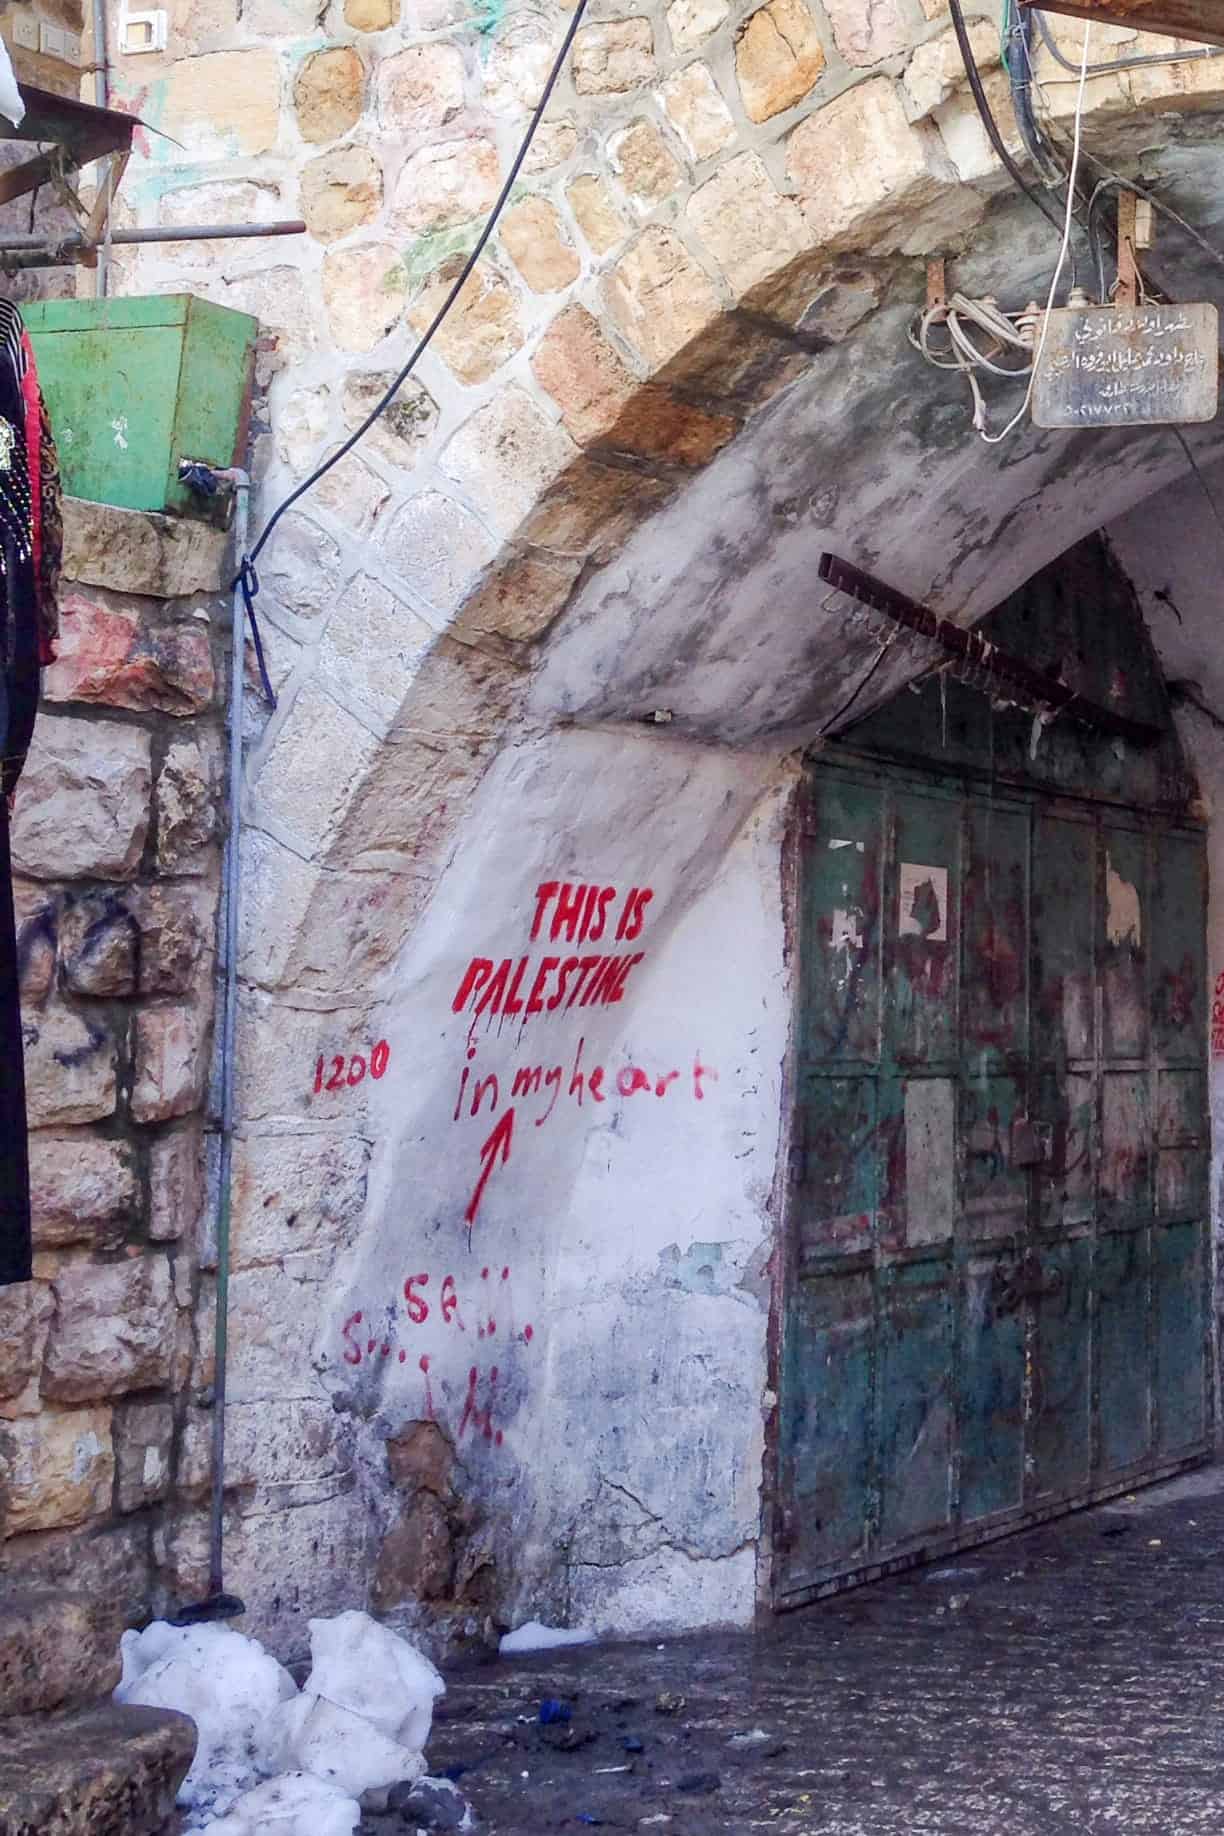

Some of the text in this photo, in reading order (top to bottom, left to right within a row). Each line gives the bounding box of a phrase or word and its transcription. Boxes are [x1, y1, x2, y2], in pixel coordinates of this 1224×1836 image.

[530, 881, 655, 942] THIS IS
[451, 951, 646, 1016] PALESTINE
[453, 1046, 499, 1121] in
